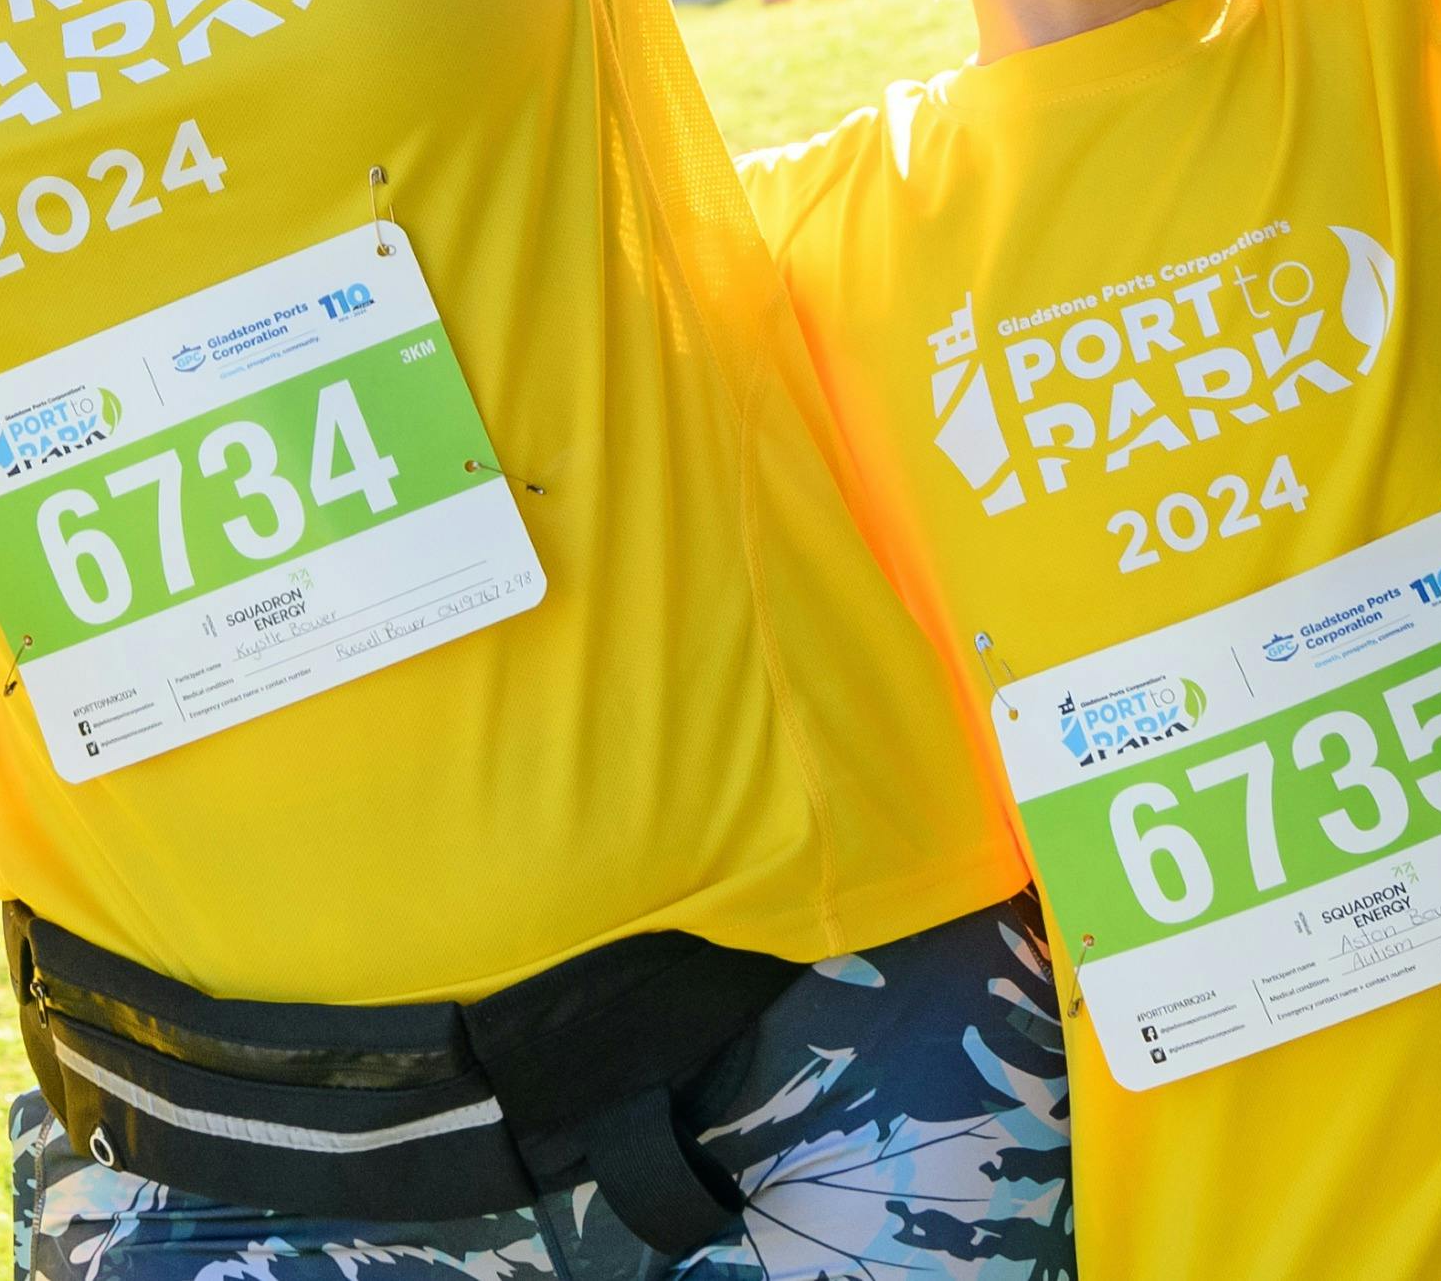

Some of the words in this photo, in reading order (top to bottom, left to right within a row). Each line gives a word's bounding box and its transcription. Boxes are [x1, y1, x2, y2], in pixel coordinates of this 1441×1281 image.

[997, 291, 1098, 337] Gladstone
[1102, 269, 1156, 304] Ports
[1160, 218, 1292, 283] Corporation's
[318, 283, 373, 320] 110
[207, 318, 272, 349] Gladstone
[274, 301, 309, 324] Ports
[212, 324, 288, 362] Corporation
[1003, 273, 1225, 404] PORT
[1233, 261, 1314, 319] to
[177, 352, 202, 369] GPC
[399, 339, 436, 364] 3KM
[8, 401, 68, 442] PORT
[70, 398, 94, 416] to
[1022, 309, 1354, 494] PARK
[18, 414, 107, 470] PARK
[37, 379, 400, 626] 6734
[1106, 454, 1309, 574] 2024
[226, 588, 302, 627] SQUADRON
[254, 601, 306, 631] ENERGY
[1300, 603, 1365, 638] Gladstone
[1368, 587, 1402, 609] Ports
[1268, 640, 1295, 658] GPC
[1305, 610, 1383, 650] Corporation
[1084, 692, 1146, 730] PORT
[1150, 688, 1175, 708] to
[1092, 705, 1189, 761] PARK
[1321, 882, 1407, 924] SQUADRON
[1353, 896, 1412, 928] ENERGY
[1262, 967, 1297, 984] Participant
[1298, 961, 1316, 972] name
[1352, 937, 1414, 970] Autism
[1137, 990, 1216, 1022] #PORTTOPARK2024
[1270, 988, 1295, 1002] Medical
[1296, 977, 1330, 994] conditions
[1277, 1003, 1314, 1021] Emergency
[1391, 964, 1417, 979] number
